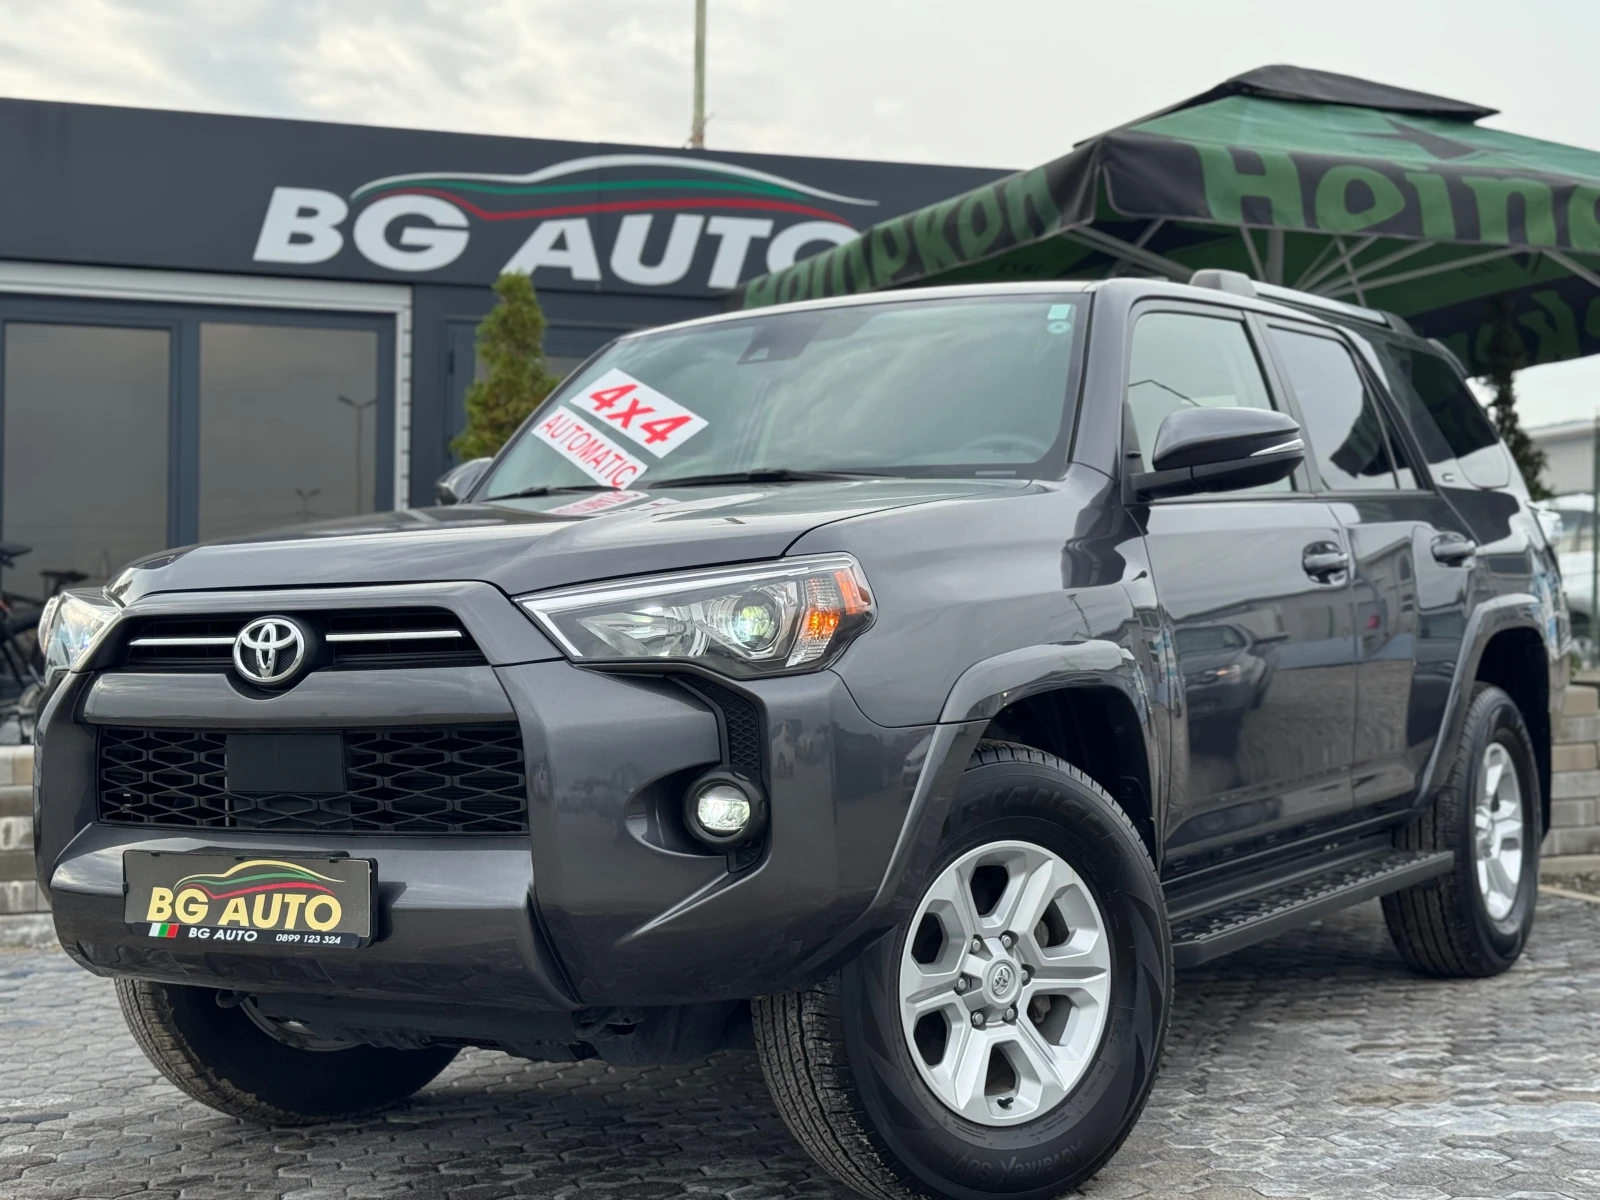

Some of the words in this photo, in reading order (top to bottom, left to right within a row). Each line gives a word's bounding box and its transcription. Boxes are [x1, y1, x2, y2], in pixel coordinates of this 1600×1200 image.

[253, 187, 470, 272] BG
[589, 384, 693, 445] 4x4
[539, 413, 638, 487] AUTOMATIC
[146, 886, 209, 924] BG
[217, 893, 342, 932] AUTO
[188, 927, 211, 939] BG
[213, 929, 258, 942] AUTO
[275, 933, 300, 943] 0899
[303, 934, 321, 944] 123
[322, 935, 342, 945] 324
